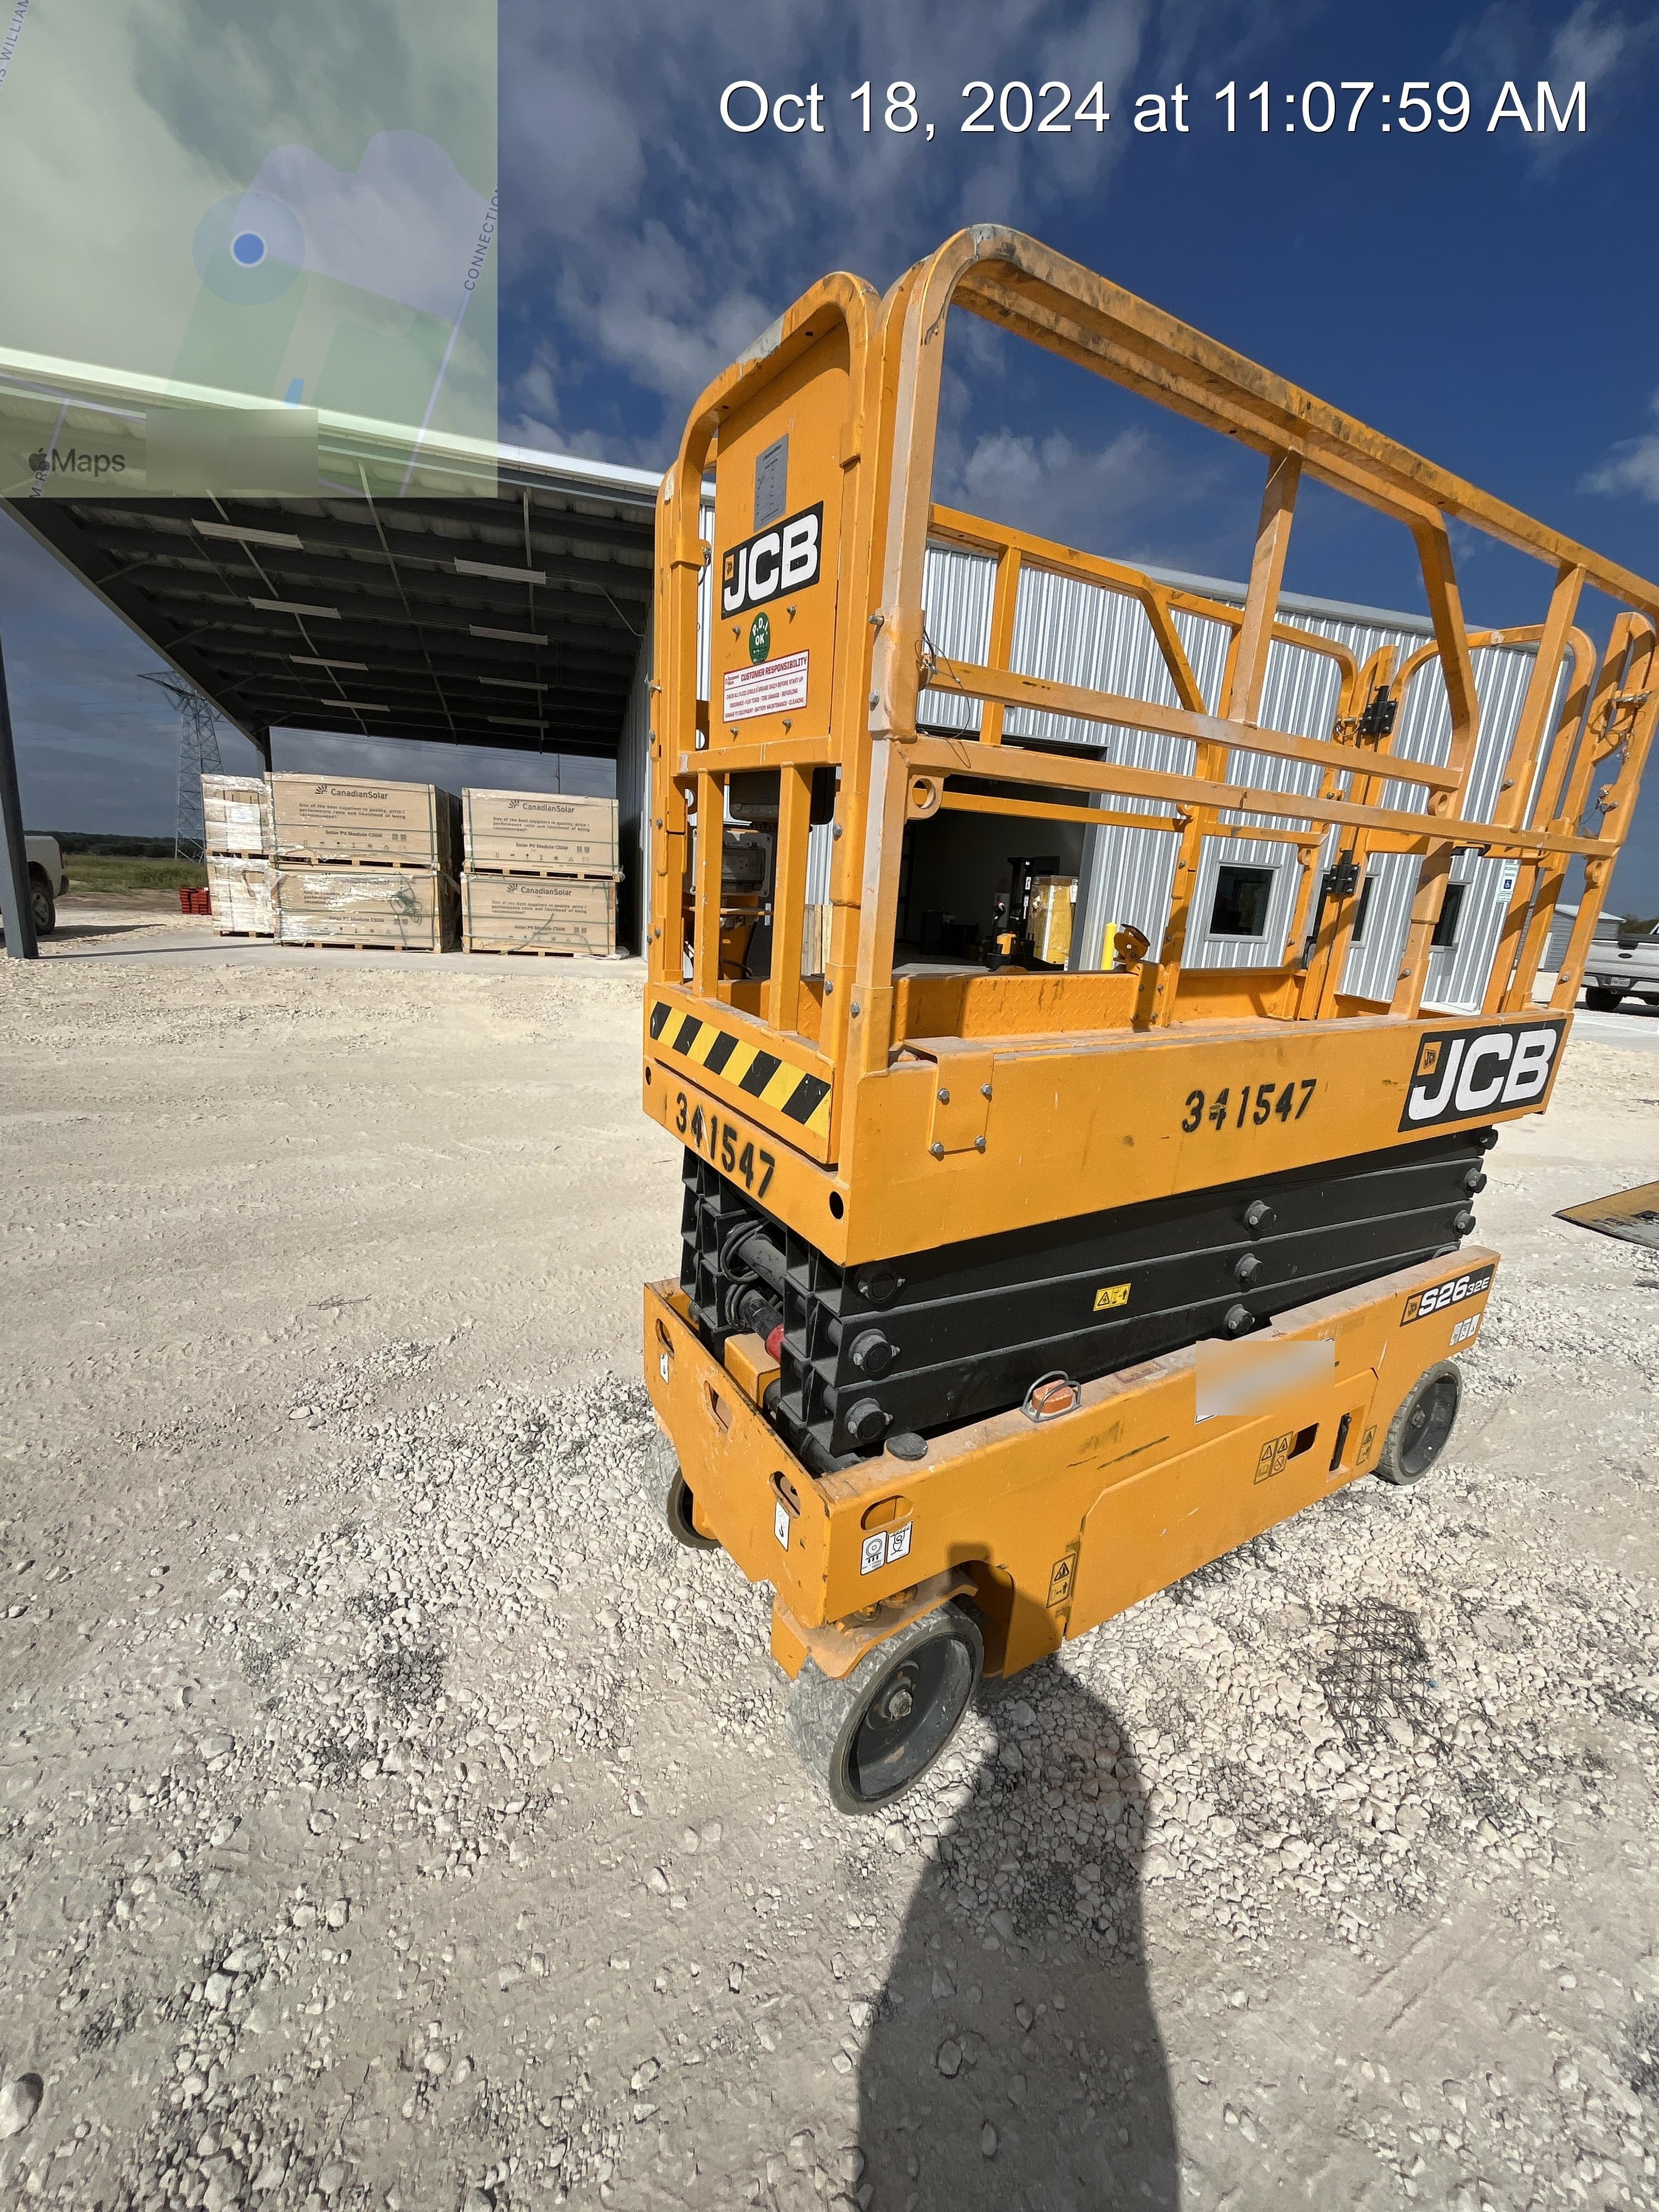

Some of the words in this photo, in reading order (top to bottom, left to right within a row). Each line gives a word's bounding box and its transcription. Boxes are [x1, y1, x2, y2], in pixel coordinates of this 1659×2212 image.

[724, 514, 819, 611] JCB
[755, 633, 765, 645] OK
[741, 668, 764, 681] CUSTOMER
[765, 656, 806, 675] RESPONSIBILITY
[331, 788, 388, 799] CanadianSolar
[523, 803, 574, 813] CanadianSolar
[521, 887, 572, 896] CanadianSolar
[1408, 1029, 1558, 1121] JCB
[1182, 1079, 1317, 1132] 341547
[676, 1092, 775, 1198] 341547
